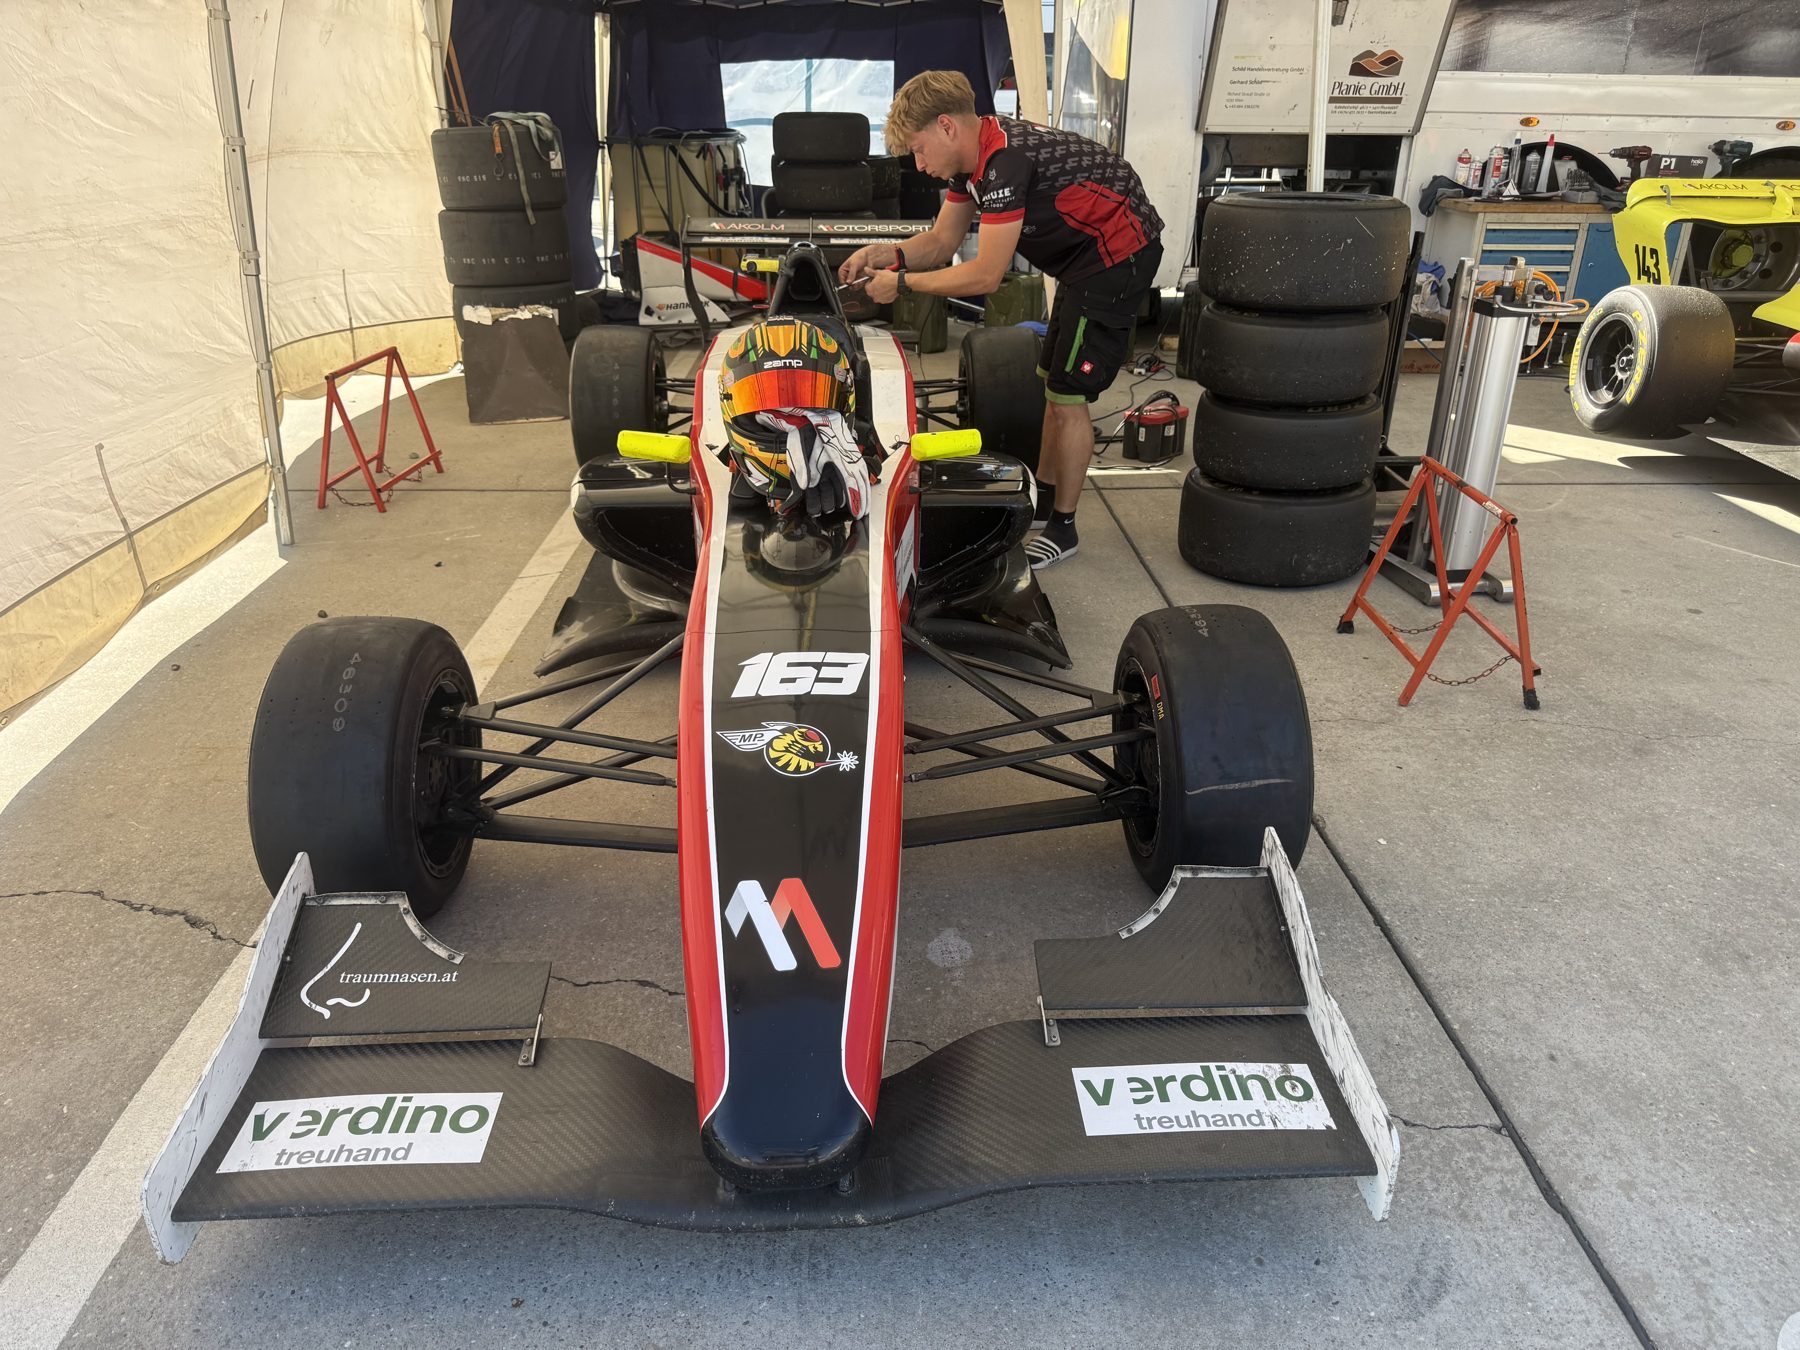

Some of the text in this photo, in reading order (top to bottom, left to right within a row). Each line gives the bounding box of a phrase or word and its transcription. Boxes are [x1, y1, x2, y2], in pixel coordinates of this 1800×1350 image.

[1331, 81, 1406, 96] Planie GmbH
[1659, 157, 1676, 170] P1
[1634, 244, 1661, 285] 143
[763, 359, 803, 369] zamp
[731, 652, 870, 698] 163
[738, 732, 765, 744] MP
[339, 969, 459, 984] traumnasen.at
[1080, 1065, 1315, 1107] verdino
[251, 1096, 490, 1143] verdino
[1133, 1109, 1267, 1130] treuhand
[274, 1142, 414, 1166] treuhand
